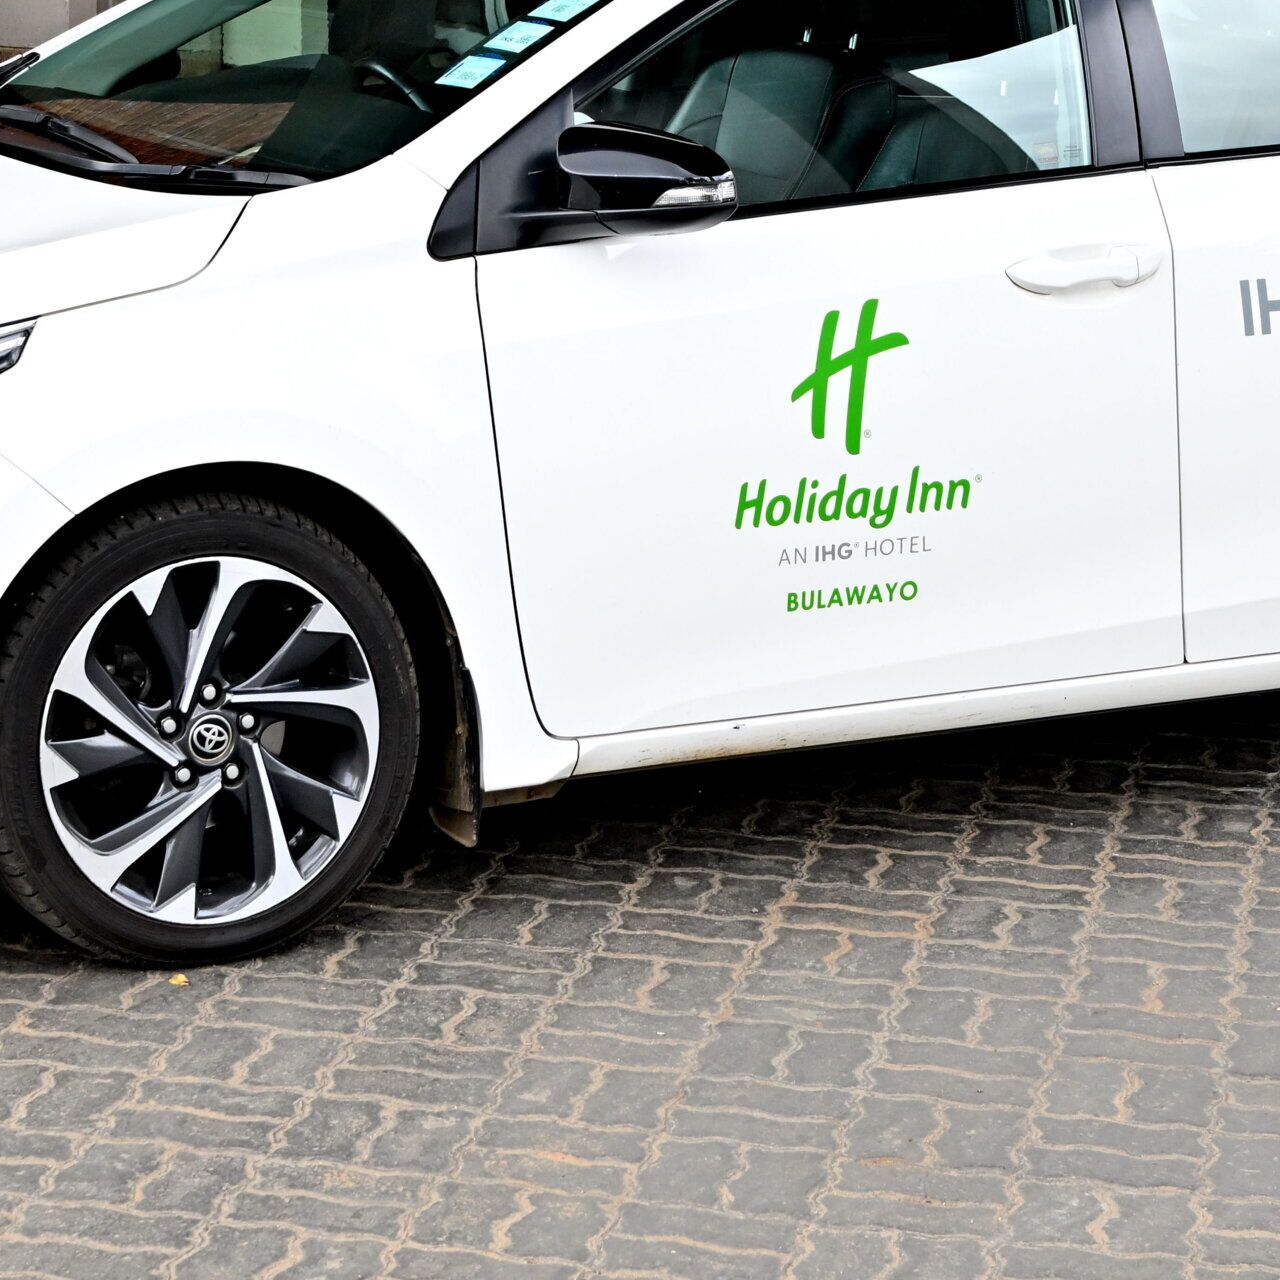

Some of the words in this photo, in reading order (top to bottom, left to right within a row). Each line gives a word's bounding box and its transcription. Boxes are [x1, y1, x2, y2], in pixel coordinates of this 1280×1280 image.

[734, 472, 899, 530] Holiday
[778, 546, 807, 567] AN
[864, 535, 932, 558] HOTEL
[786, 580, 919, 613] BULAWAYO
